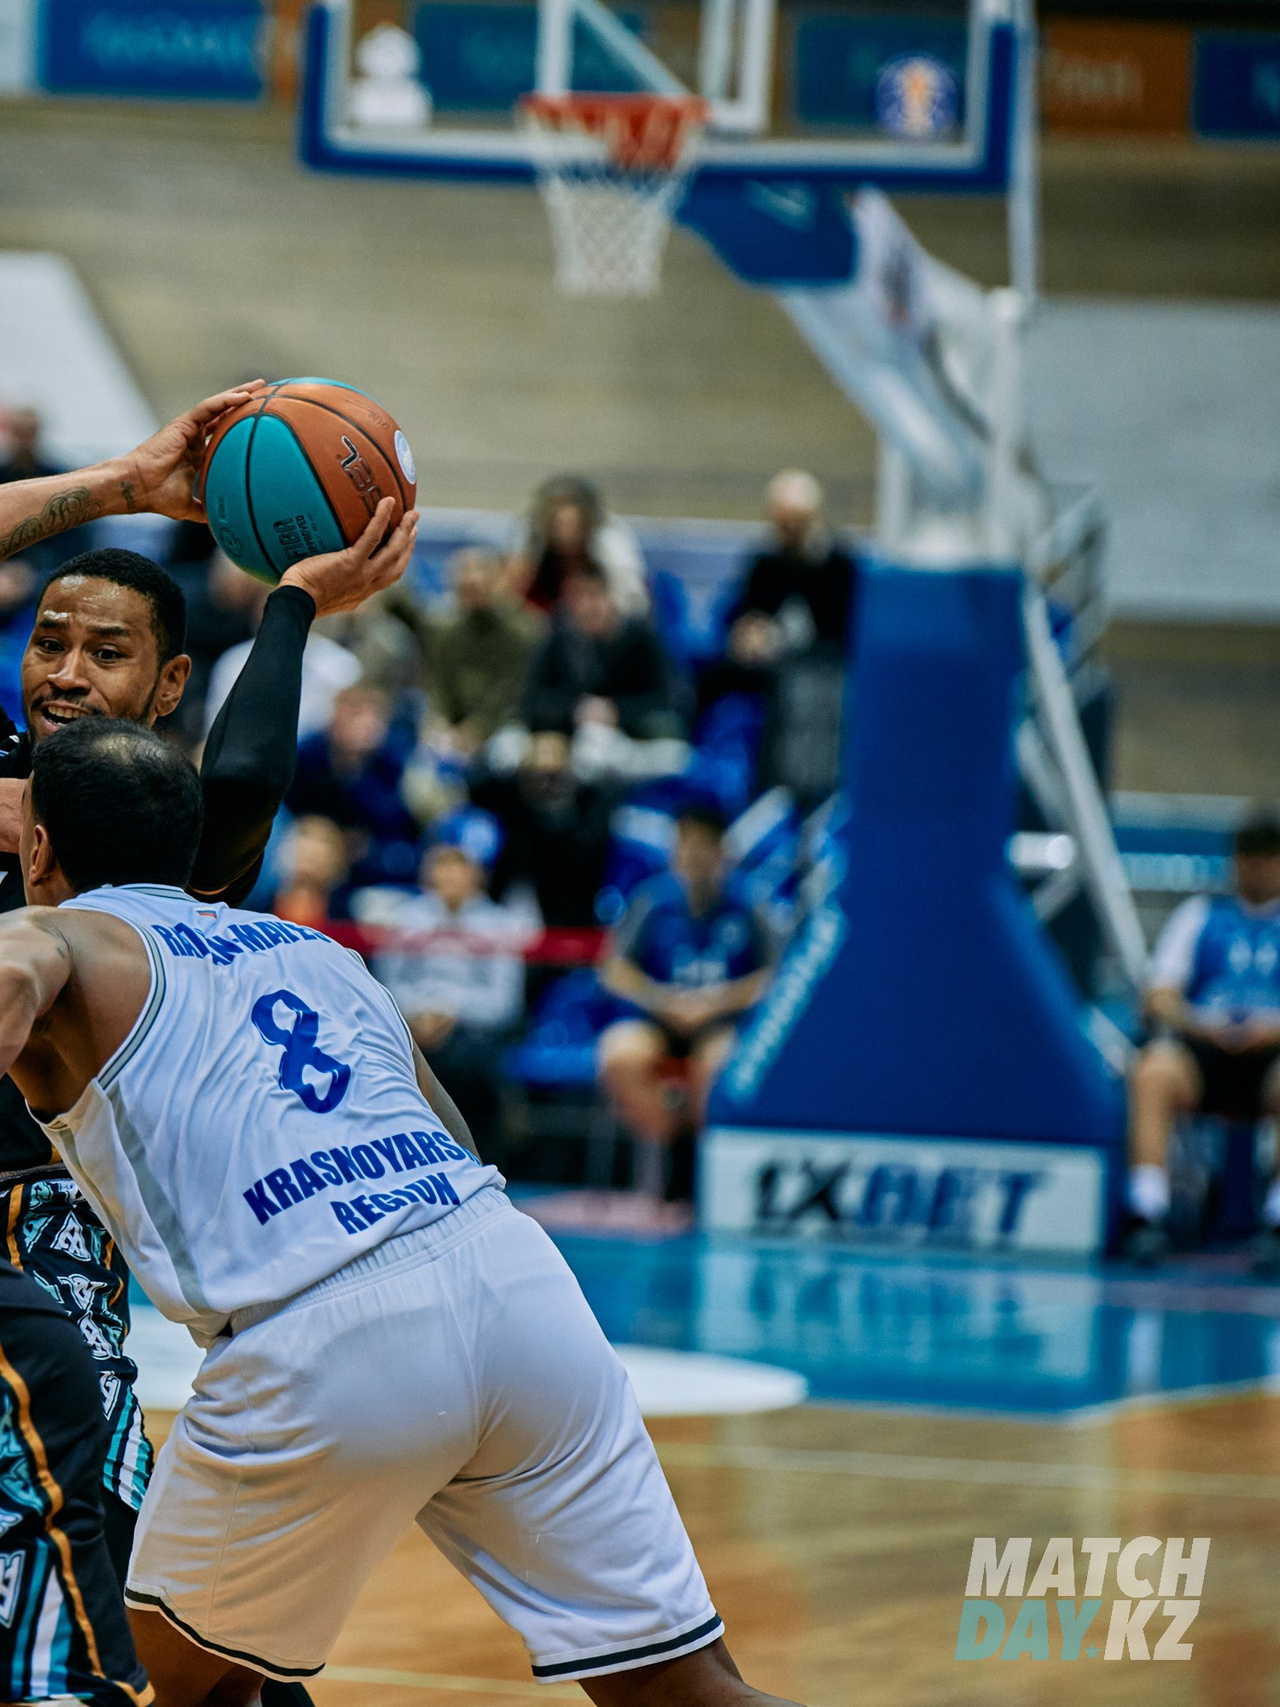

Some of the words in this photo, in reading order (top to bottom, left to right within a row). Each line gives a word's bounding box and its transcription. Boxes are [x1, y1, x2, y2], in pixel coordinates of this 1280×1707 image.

[251, 989, 351, 1114] 8
[242, 1130, 482, 1226] KRASNOYARS
[330, 1171, 461, 1235] REGION
